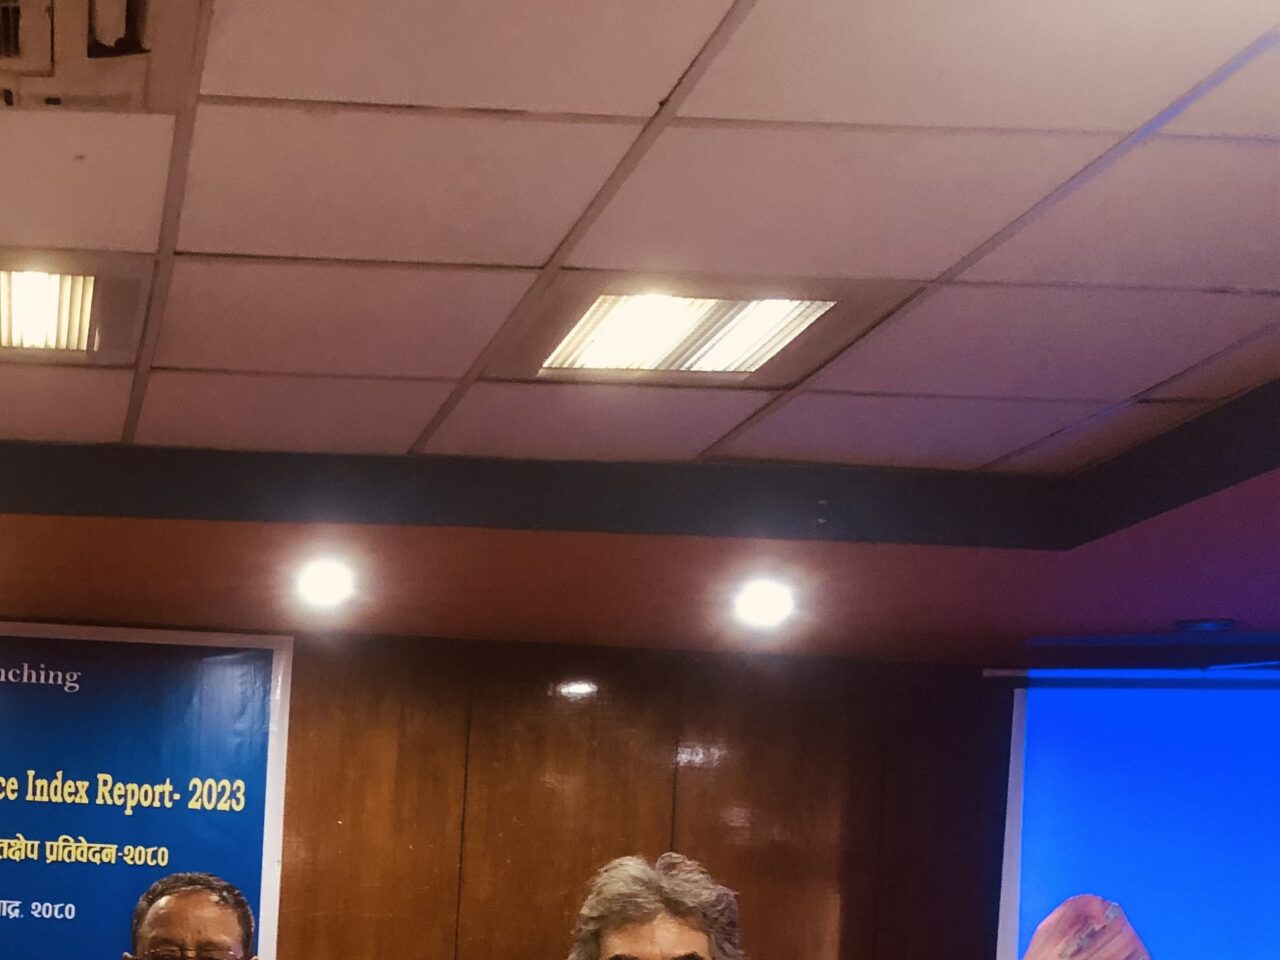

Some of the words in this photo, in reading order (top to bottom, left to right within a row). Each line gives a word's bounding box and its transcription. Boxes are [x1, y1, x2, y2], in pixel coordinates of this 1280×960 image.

[25, 770, 89, 804] Index
[95, 773, 181, 815] Report-
[187, 777, 245, 812] 2023
[31, 902, 76, 920] २०८०
